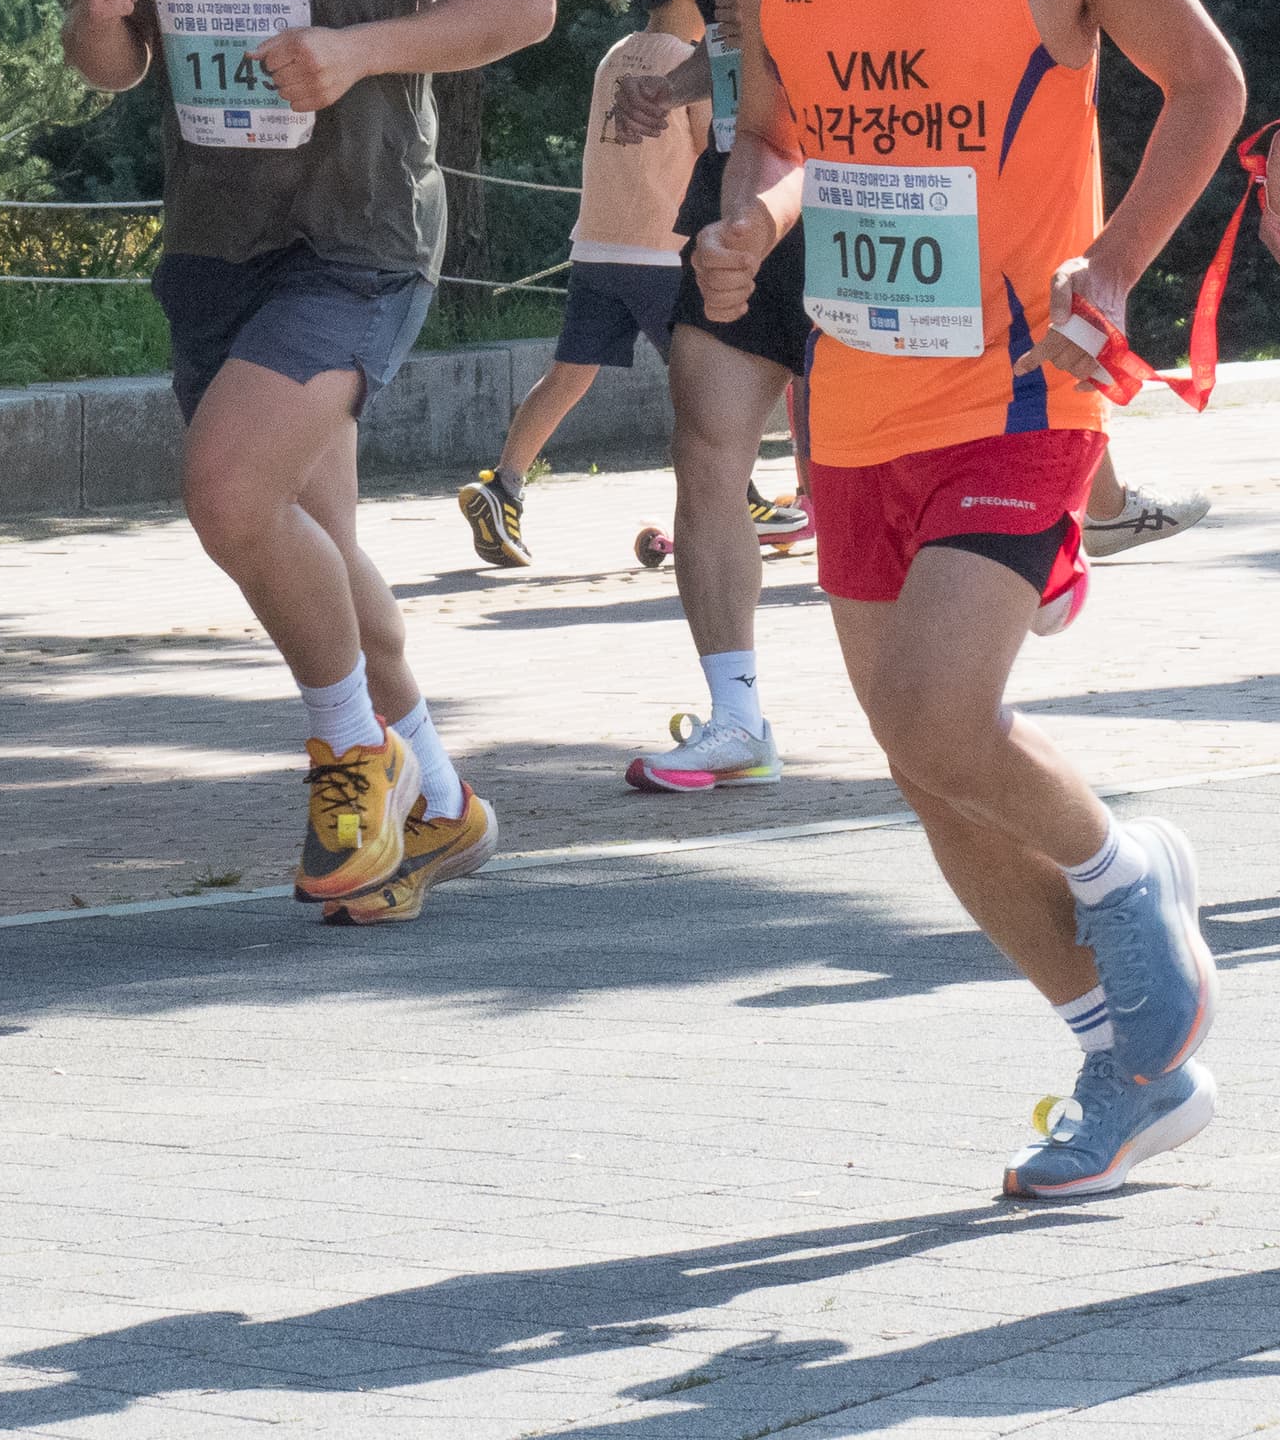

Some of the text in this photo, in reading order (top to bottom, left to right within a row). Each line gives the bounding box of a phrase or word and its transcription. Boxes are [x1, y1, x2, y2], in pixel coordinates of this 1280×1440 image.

[174, 17, 270, 32] 어울림 마라톤대회
[827, 48, 929, 91] VMK
[815, 168, 952, 189] 제10회 시각장애인과 함께하는
[819, 187, 925, 210] 어울림 마라톤대회
[833, 231, 943, 285] 1070
